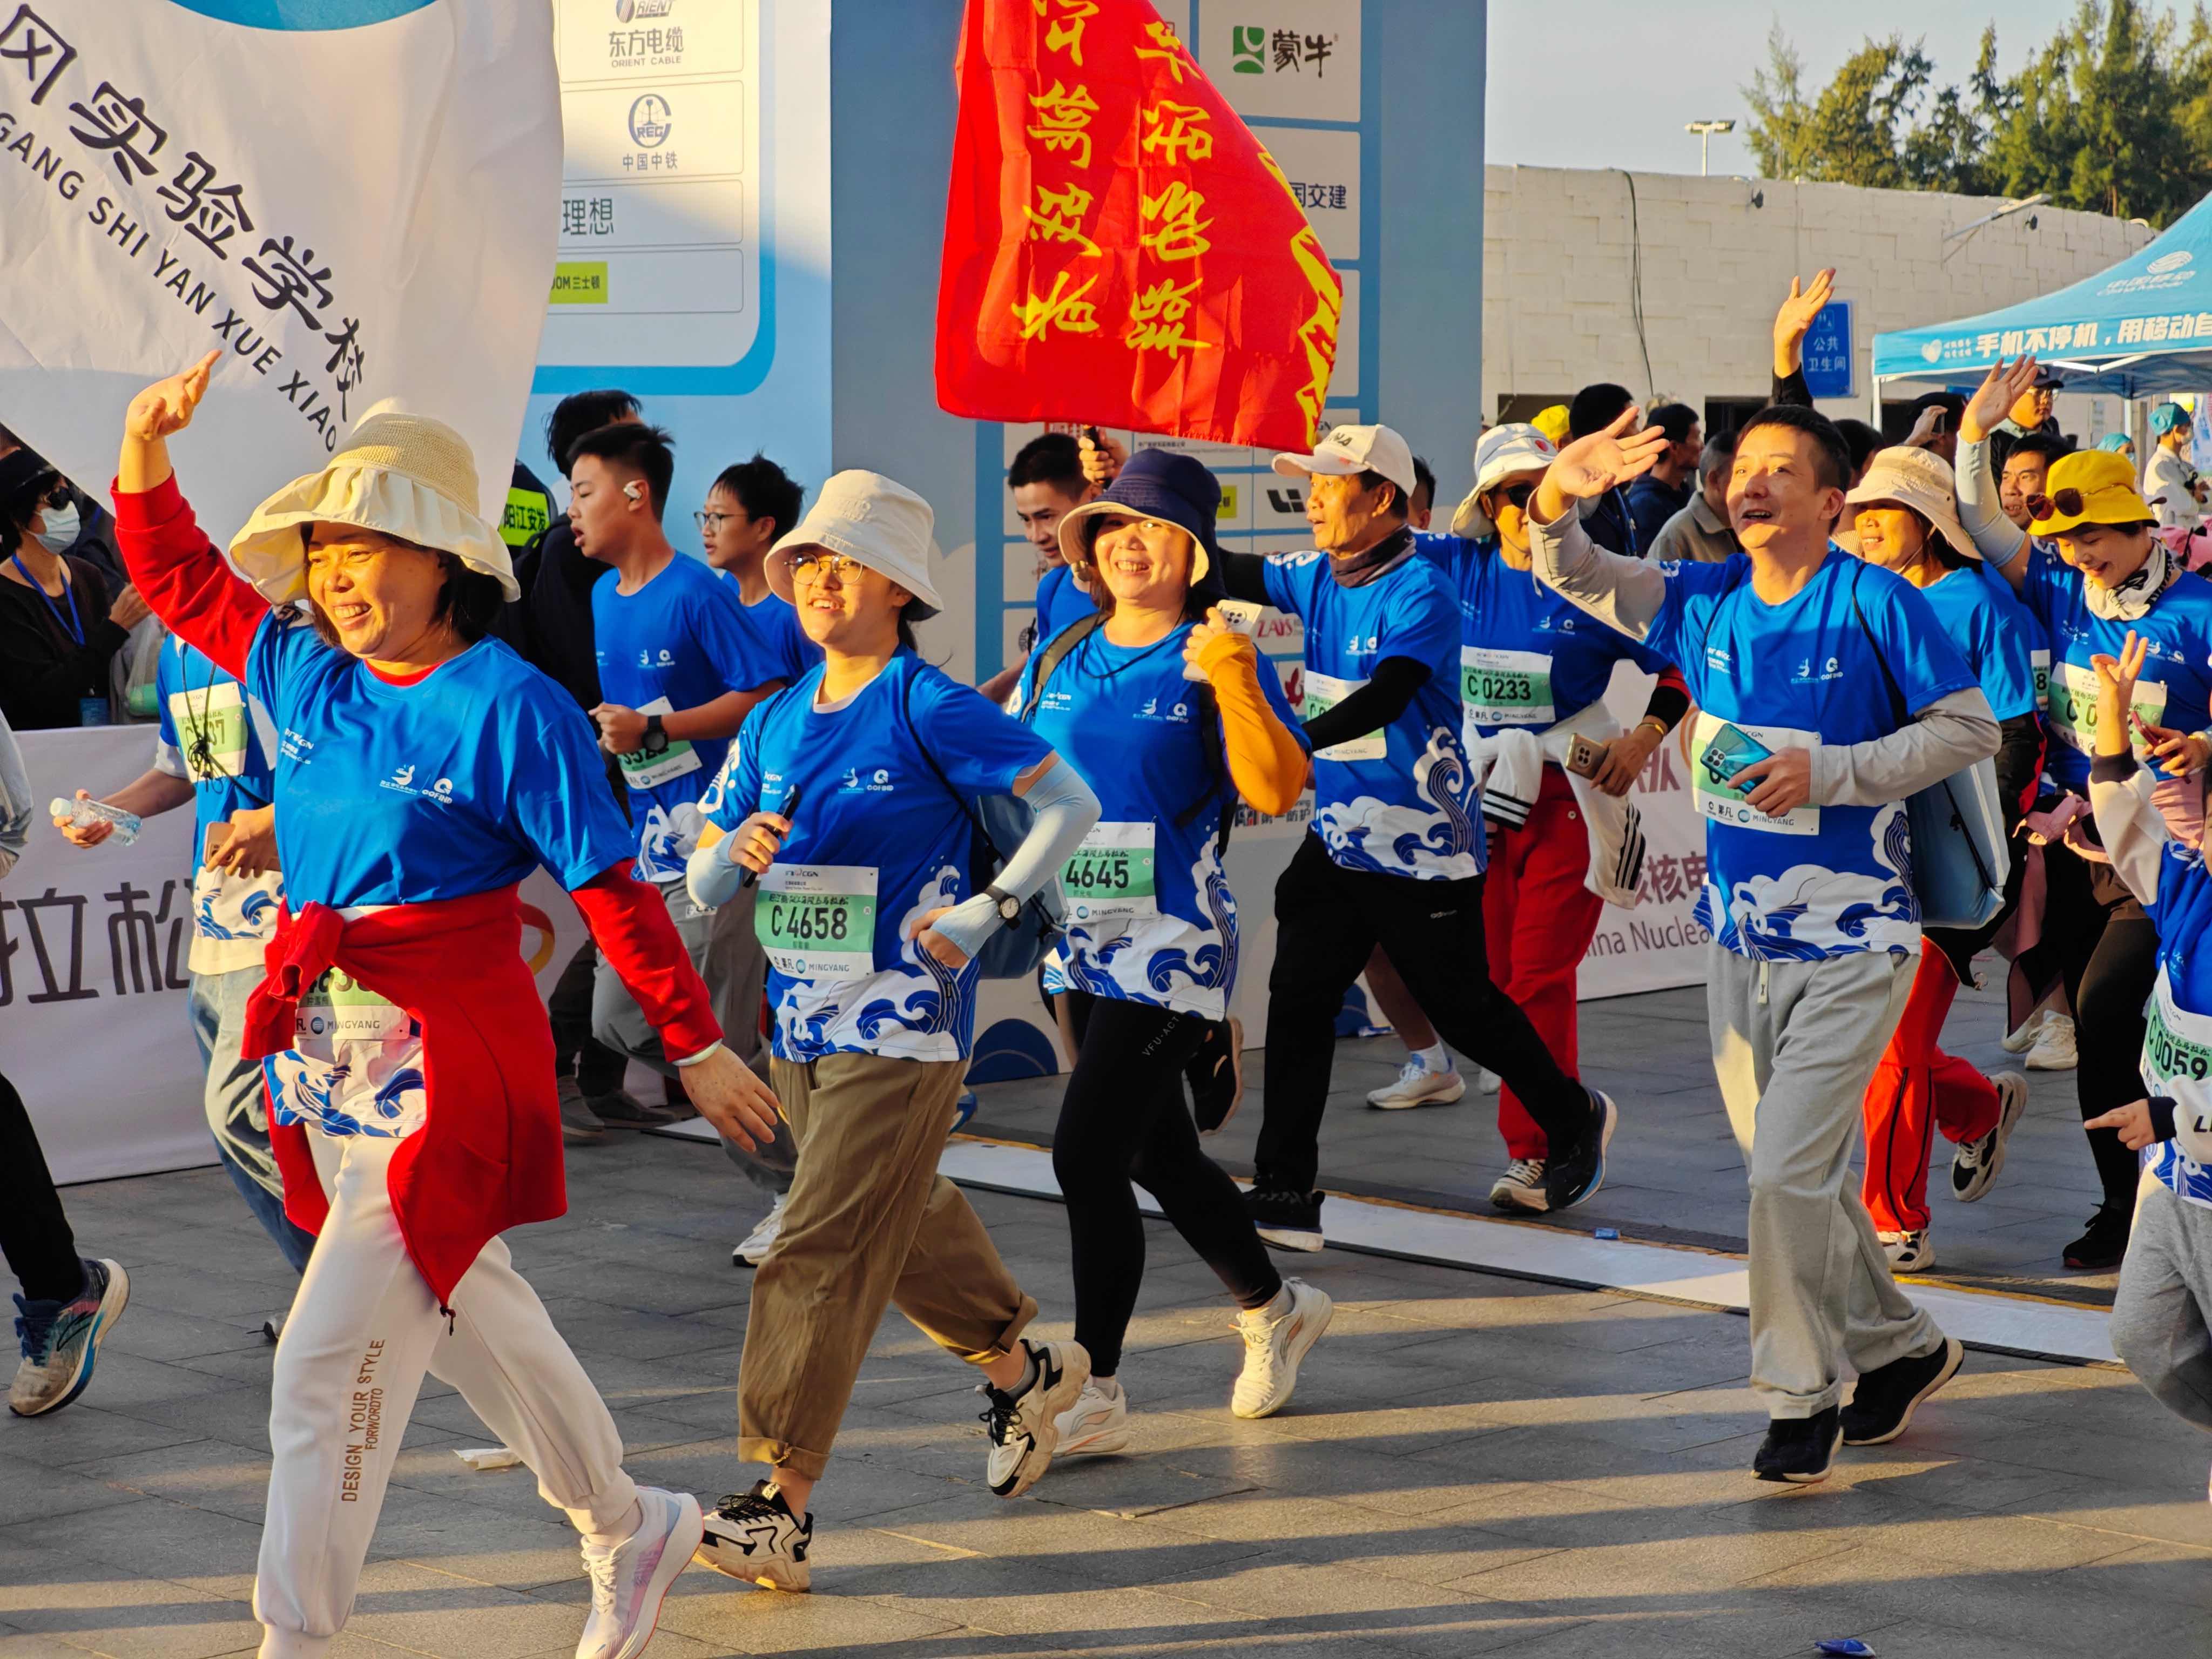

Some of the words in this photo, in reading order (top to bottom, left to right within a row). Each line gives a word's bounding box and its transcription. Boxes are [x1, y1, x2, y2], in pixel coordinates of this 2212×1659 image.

[609, 26, 684, 58] 东方电缆
[1272, 29, 1333, 78] 蒙牛
[611, 58, 646, 68] ORIENT
[651, 56, 682, 65] CABLE
[623, 151, 678, 172] 中国中铁
[563, 198, 614, 235] 理想
[88, 197, 150, 258] SHI
[153, 249, 217, 315] YAN
[211, 308, 284, 375] XUE
[277, 369, 337, 453] XIAO
[1813, 335, 1839, 351] 公共
[1808, 356, 1846, 372] 卫生间
[1752, 814, 1795, 826] MINGYANG
[1065, 859, 1129, 888] 4645
[808, 963, 849, 972] MINGYANG
[327, 1020, 380, 1029] MINGYANG
[357, 1339, 385, 1384] STYLE
[349, 1391, 370, 1433] YOUR
[365, 1388, 384, 1451] FORWORDTO
[341, 1445, 363, 1502] DESIGN
